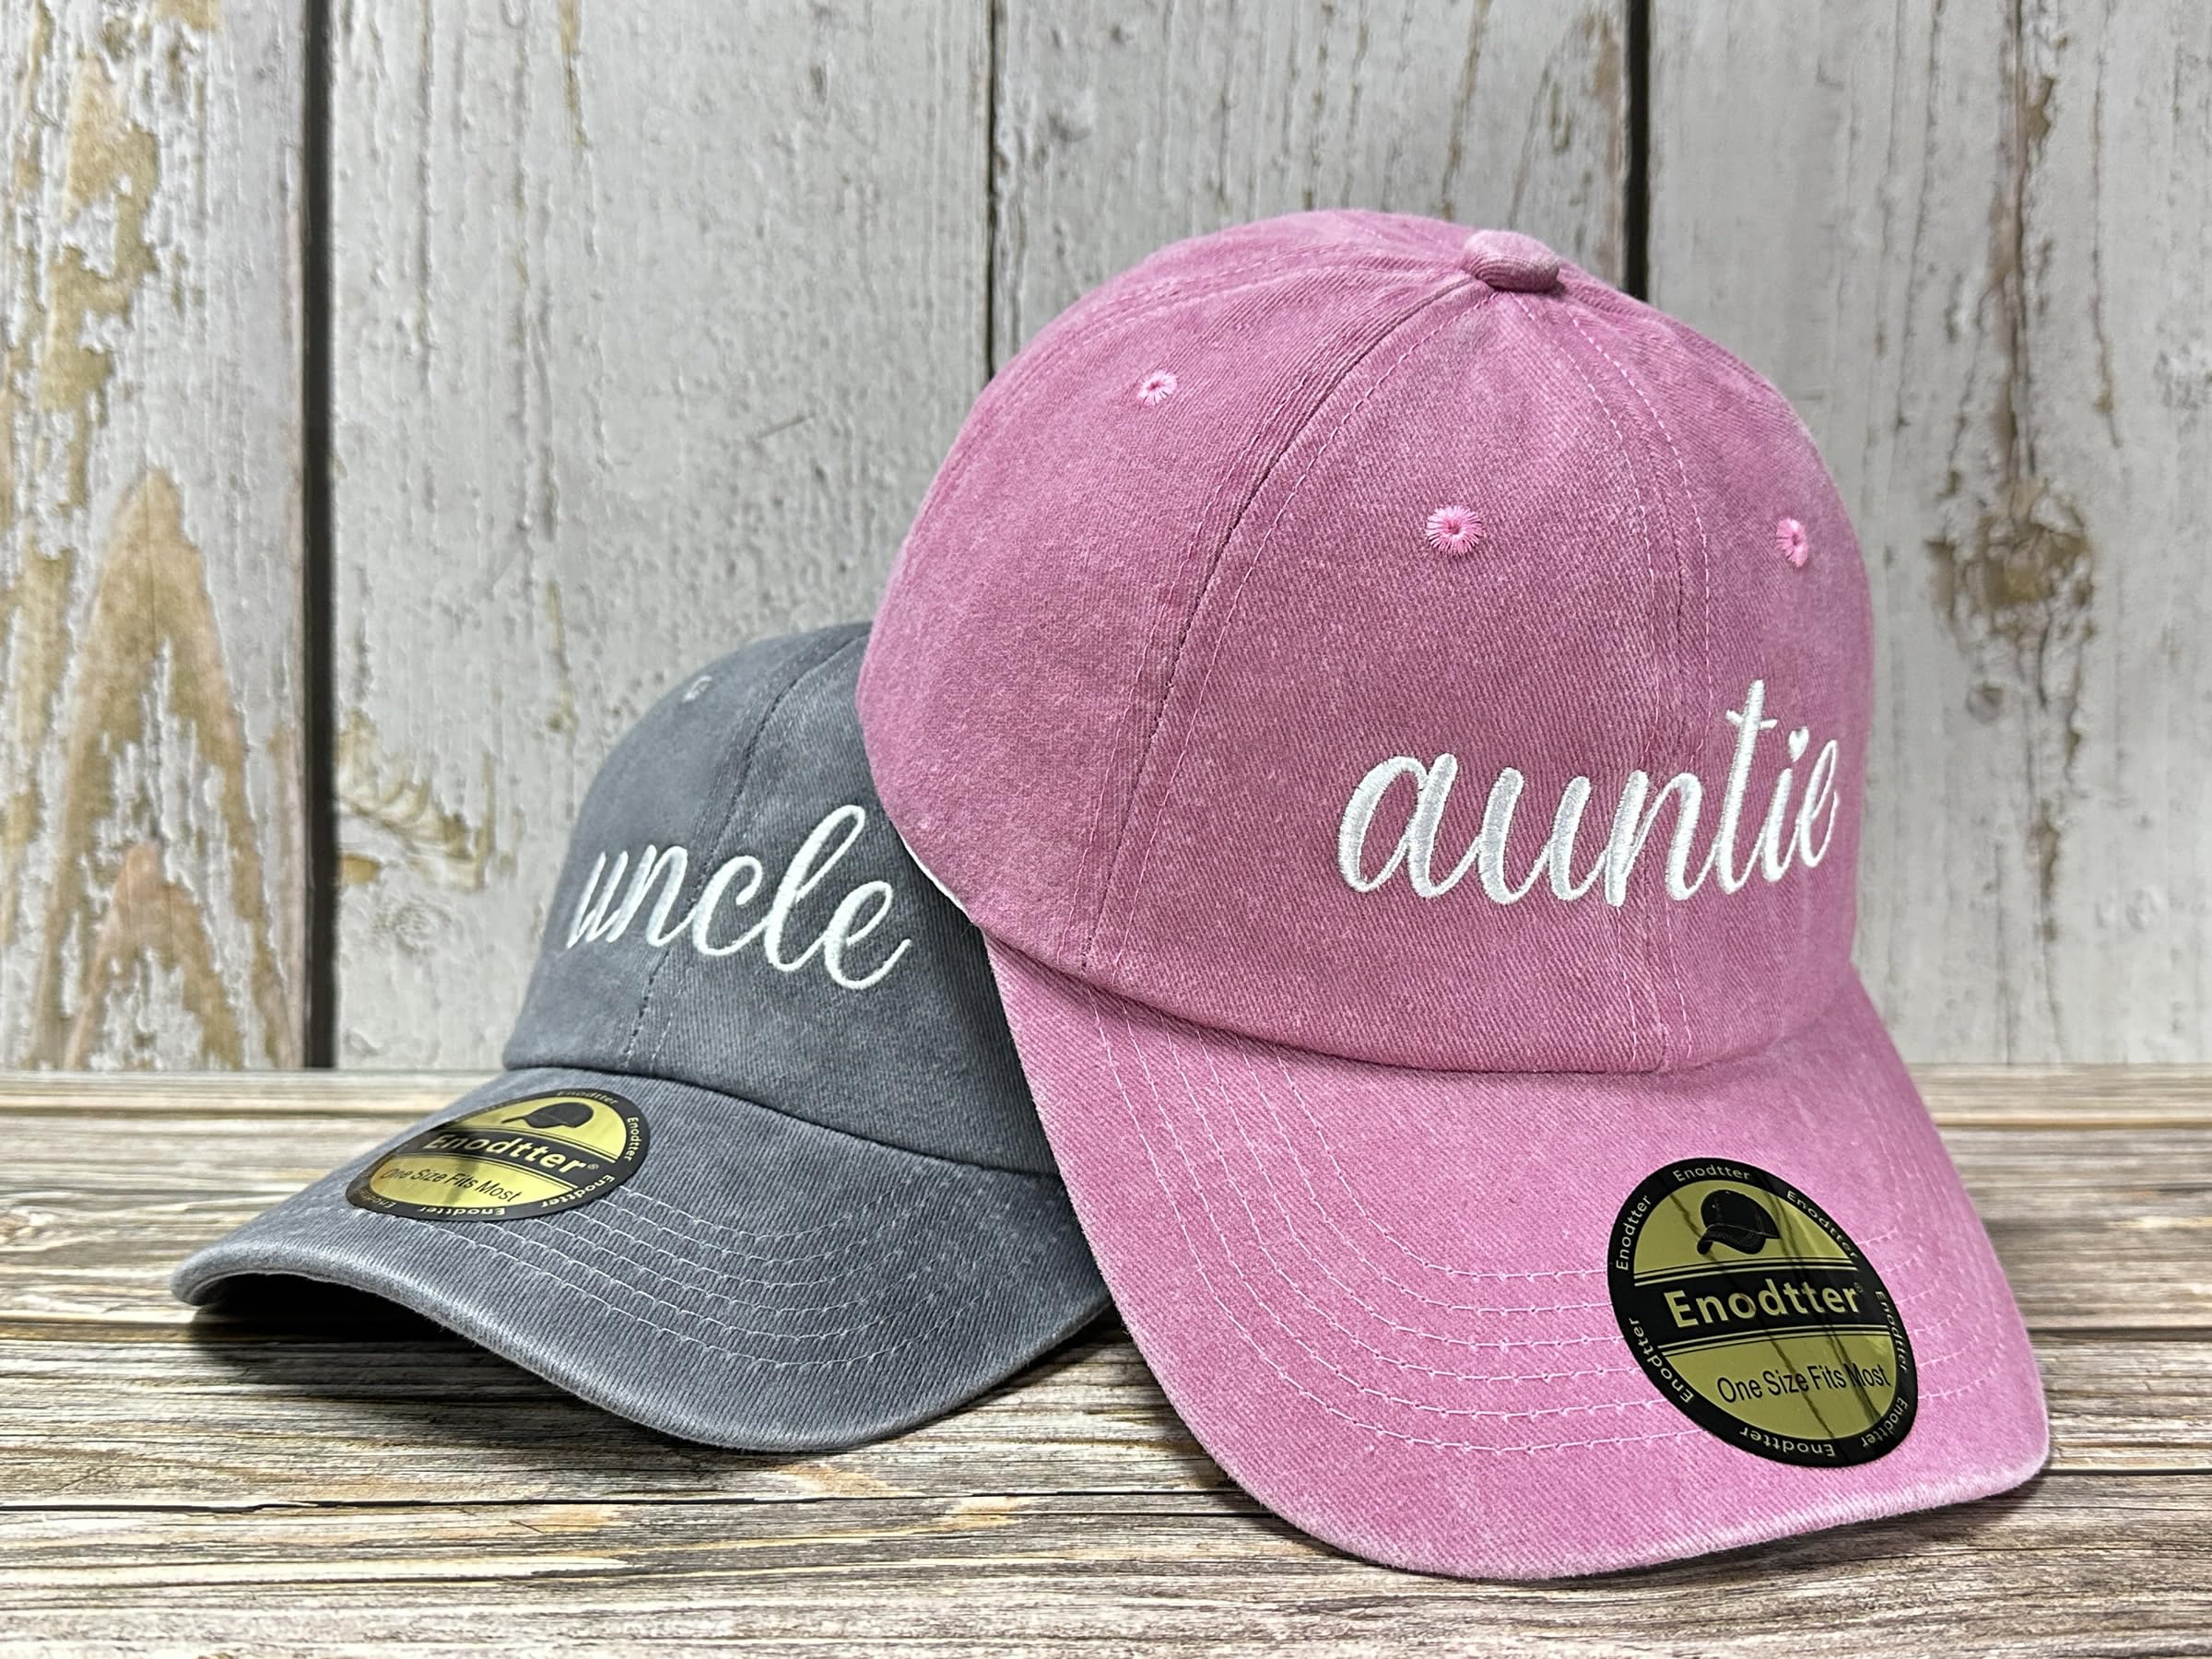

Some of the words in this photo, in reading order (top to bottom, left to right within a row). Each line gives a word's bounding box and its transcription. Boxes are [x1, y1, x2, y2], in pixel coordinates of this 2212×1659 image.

[1338, 679, 1841, 907] auntie
[567, 805, 912, 989] uncle
[423, 1135, 587, 1173] Enodtter
[624, 1117, 642, 1161] Enodtter
[380, 1168, 411, 1180] One
[411, 1169, 444, 1182] Size
[443, 1173, 478, 1189] Fits
[475, 1180, 523, 1203] Most
[542, 1174, 616, 1207] Enodtter
[1672, 1165, 1751, 1182] Enodtter
[418, 1206, 506, 1216] Enodtter
[1616, 1194, 1650, 1271] Enodtter
[1786, 1190, 1859, 1260] Enodtter
[1664, 1278, 1859, 1328] Enodtter
[1875, 1290, 1909, 1375] Enodtter
[1628, 1317, 1694, 1404] Enodtter
[1717, 1376, 1762, 1404] One
[1763, 1370, 1807, 1396] Size
[1809, 1364, 1846, 1390] Fits
[1846, 1362, 1890, 1387] Most
[1739, 1427, 1836, 1458] Enodtter
[1861, 1396, 1909, 1448] Enodtter
